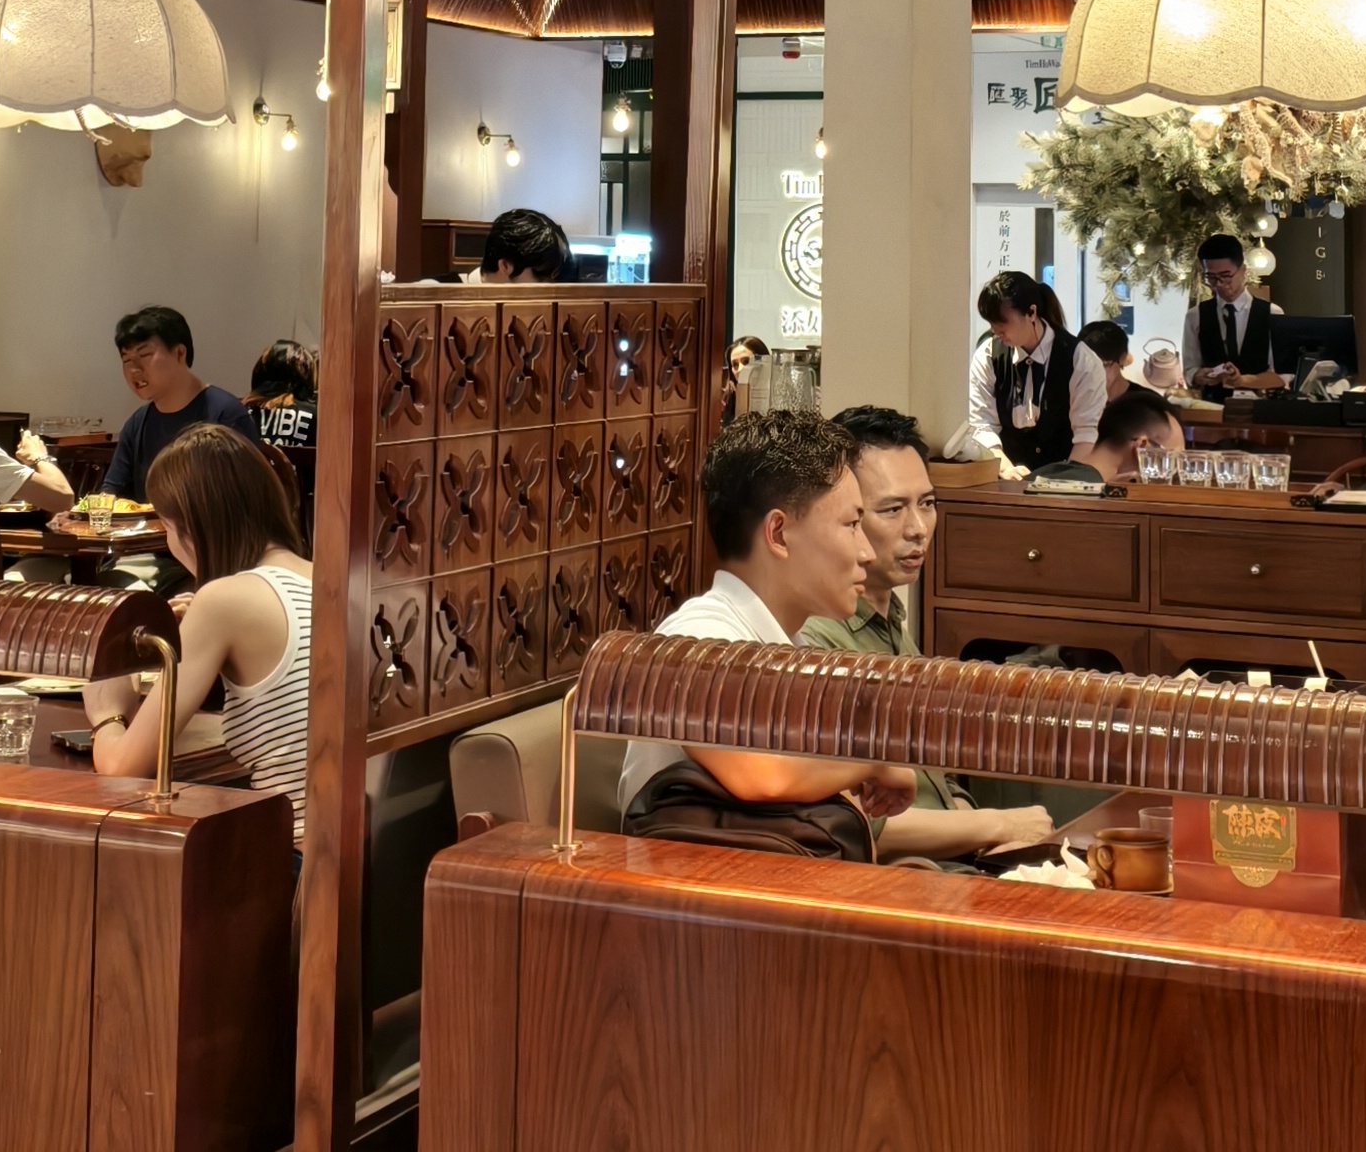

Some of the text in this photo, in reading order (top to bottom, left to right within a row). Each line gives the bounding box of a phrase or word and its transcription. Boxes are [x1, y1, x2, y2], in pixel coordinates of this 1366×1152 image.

[998, 210, 1012, 275] 於前方正
[260, 406, 314, 441] VIBE
